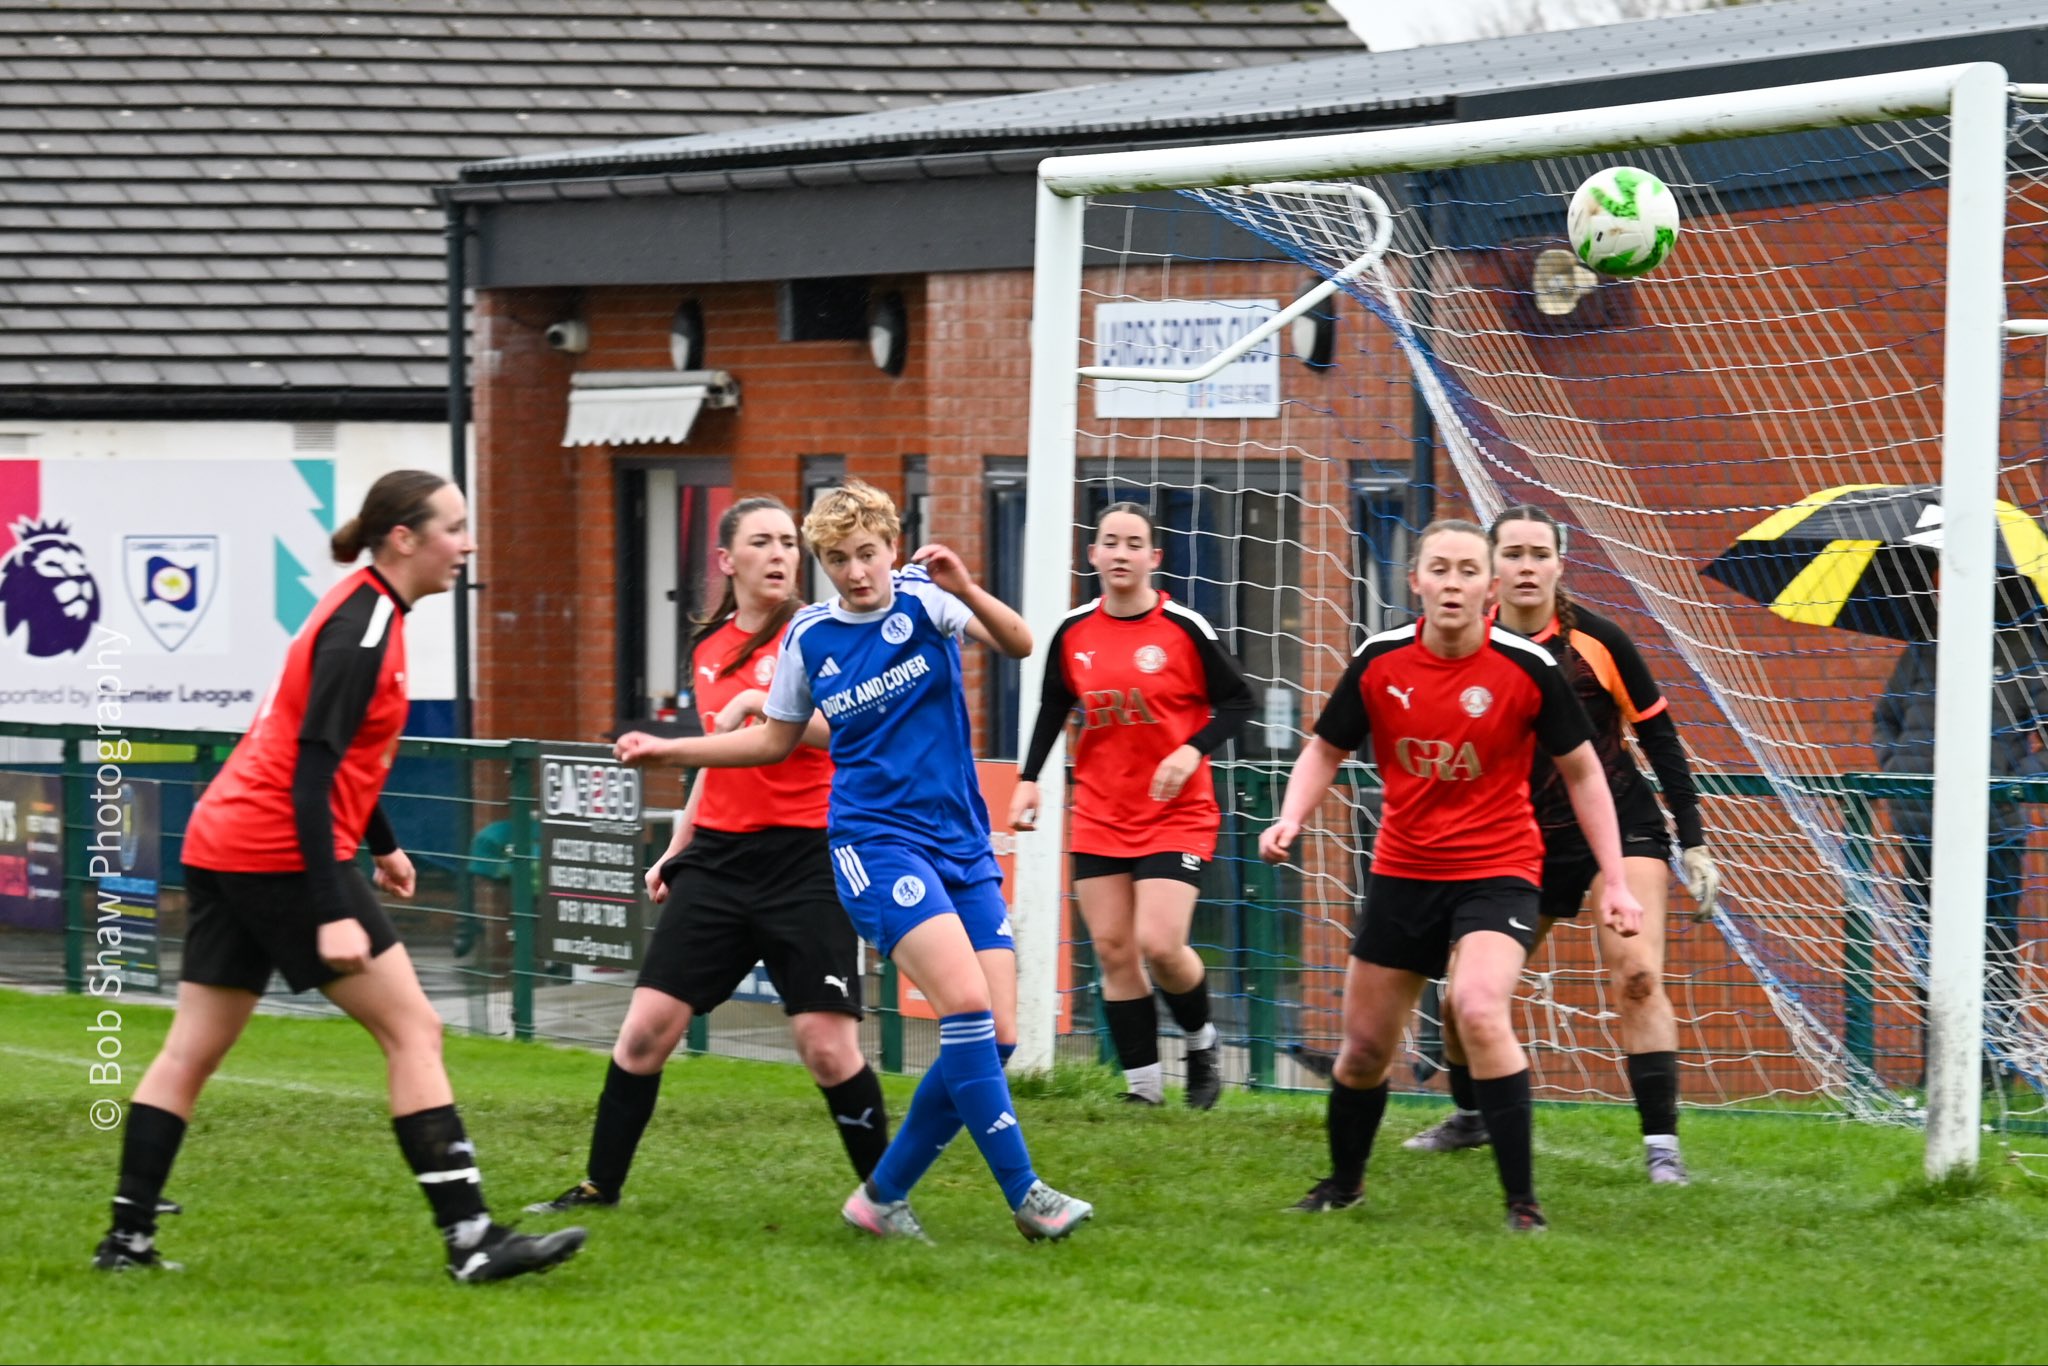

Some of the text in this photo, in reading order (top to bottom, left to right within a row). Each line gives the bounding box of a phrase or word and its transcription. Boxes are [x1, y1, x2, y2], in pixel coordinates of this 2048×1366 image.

[1161, 317, 1223, 366] SPORTS
[179, 684, 254, 707] League
[821, 654, 931, 719] DUCK AND COVER
[1395, 737, 1484, 781] GRA
